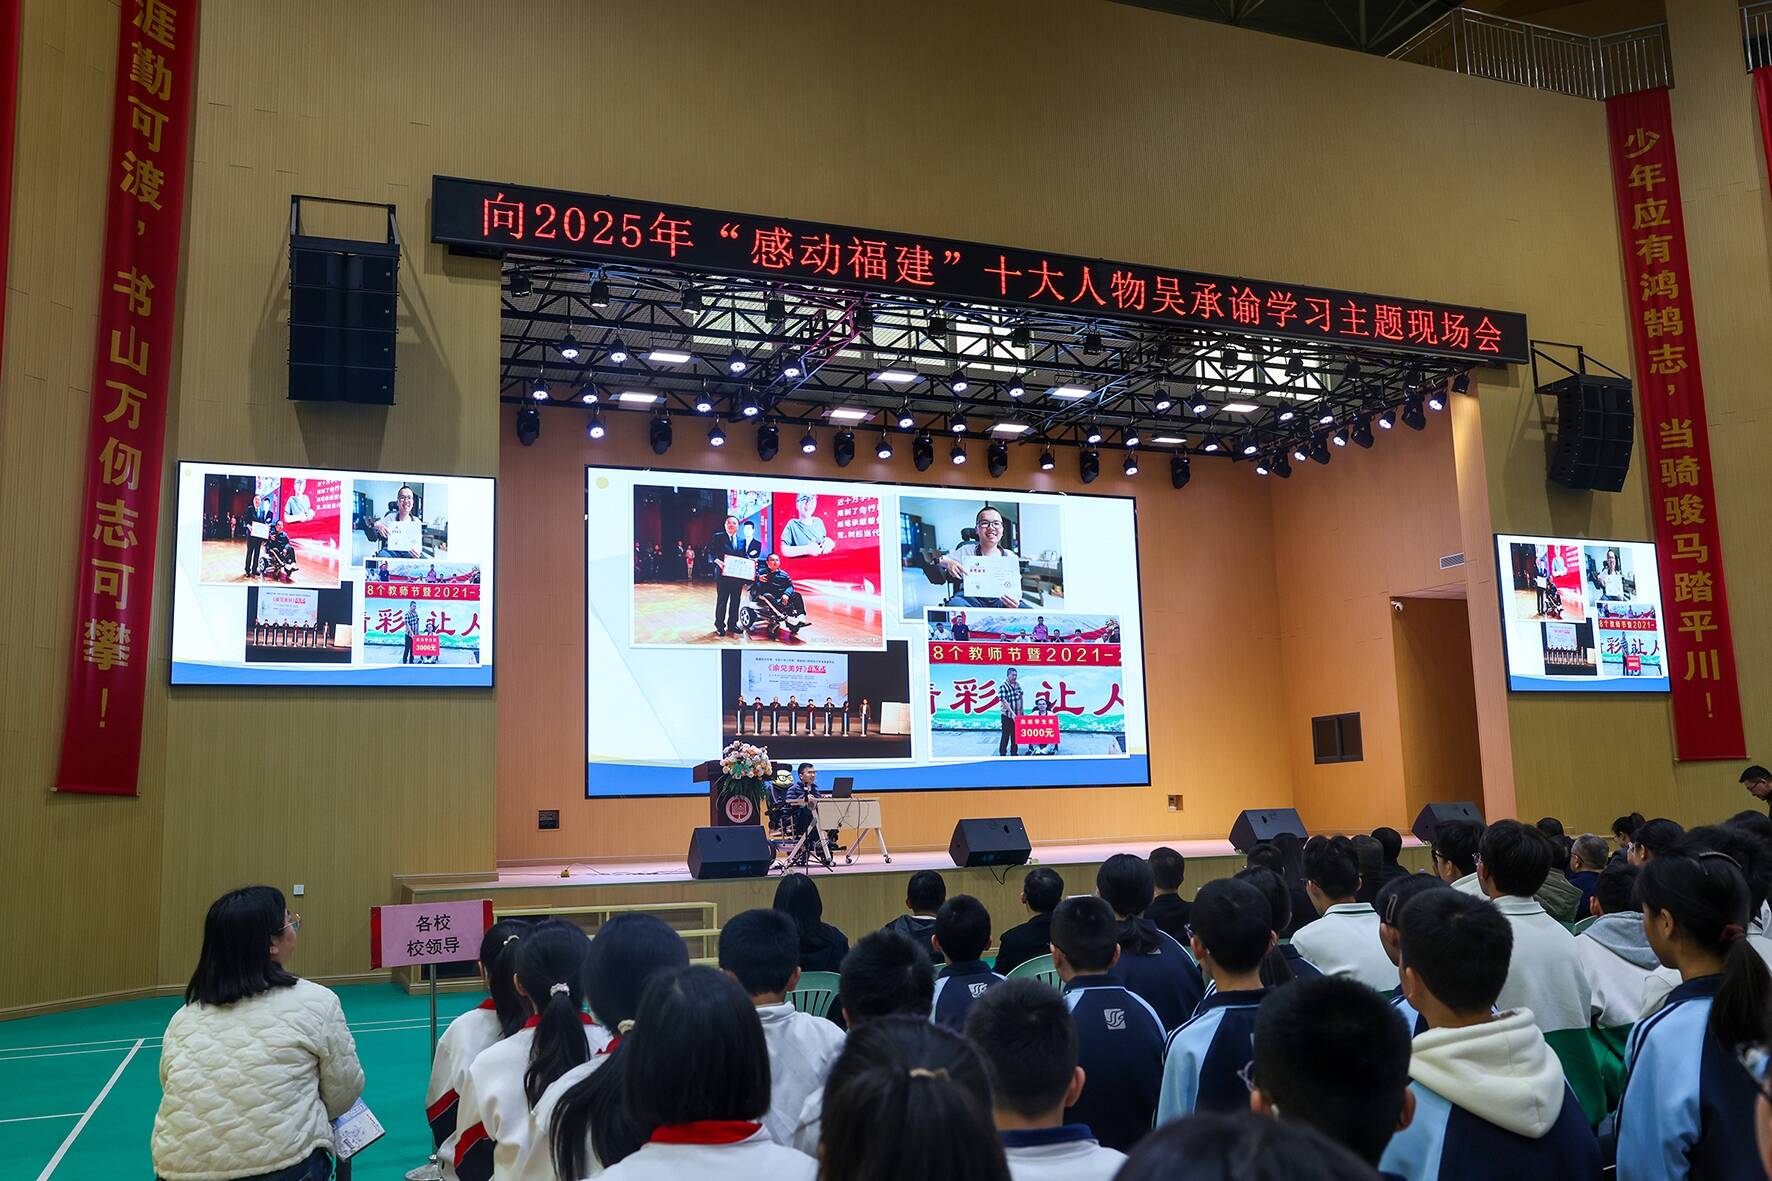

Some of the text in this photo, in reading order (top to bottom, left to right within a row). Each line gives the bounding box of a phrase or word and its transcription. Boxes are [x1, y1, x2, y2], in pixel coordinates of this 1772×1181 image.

[1624, 127, 1721, 718] 少年应有鸿鹄志，当骑骏马踏平川！
[367, 585, 480, 598] 8个教师节暨2021-
[1020, 728, 1054, 738] 3000元
[416, 914, 451, 932] 各校
[407, 936, 460, 957] 校领导
